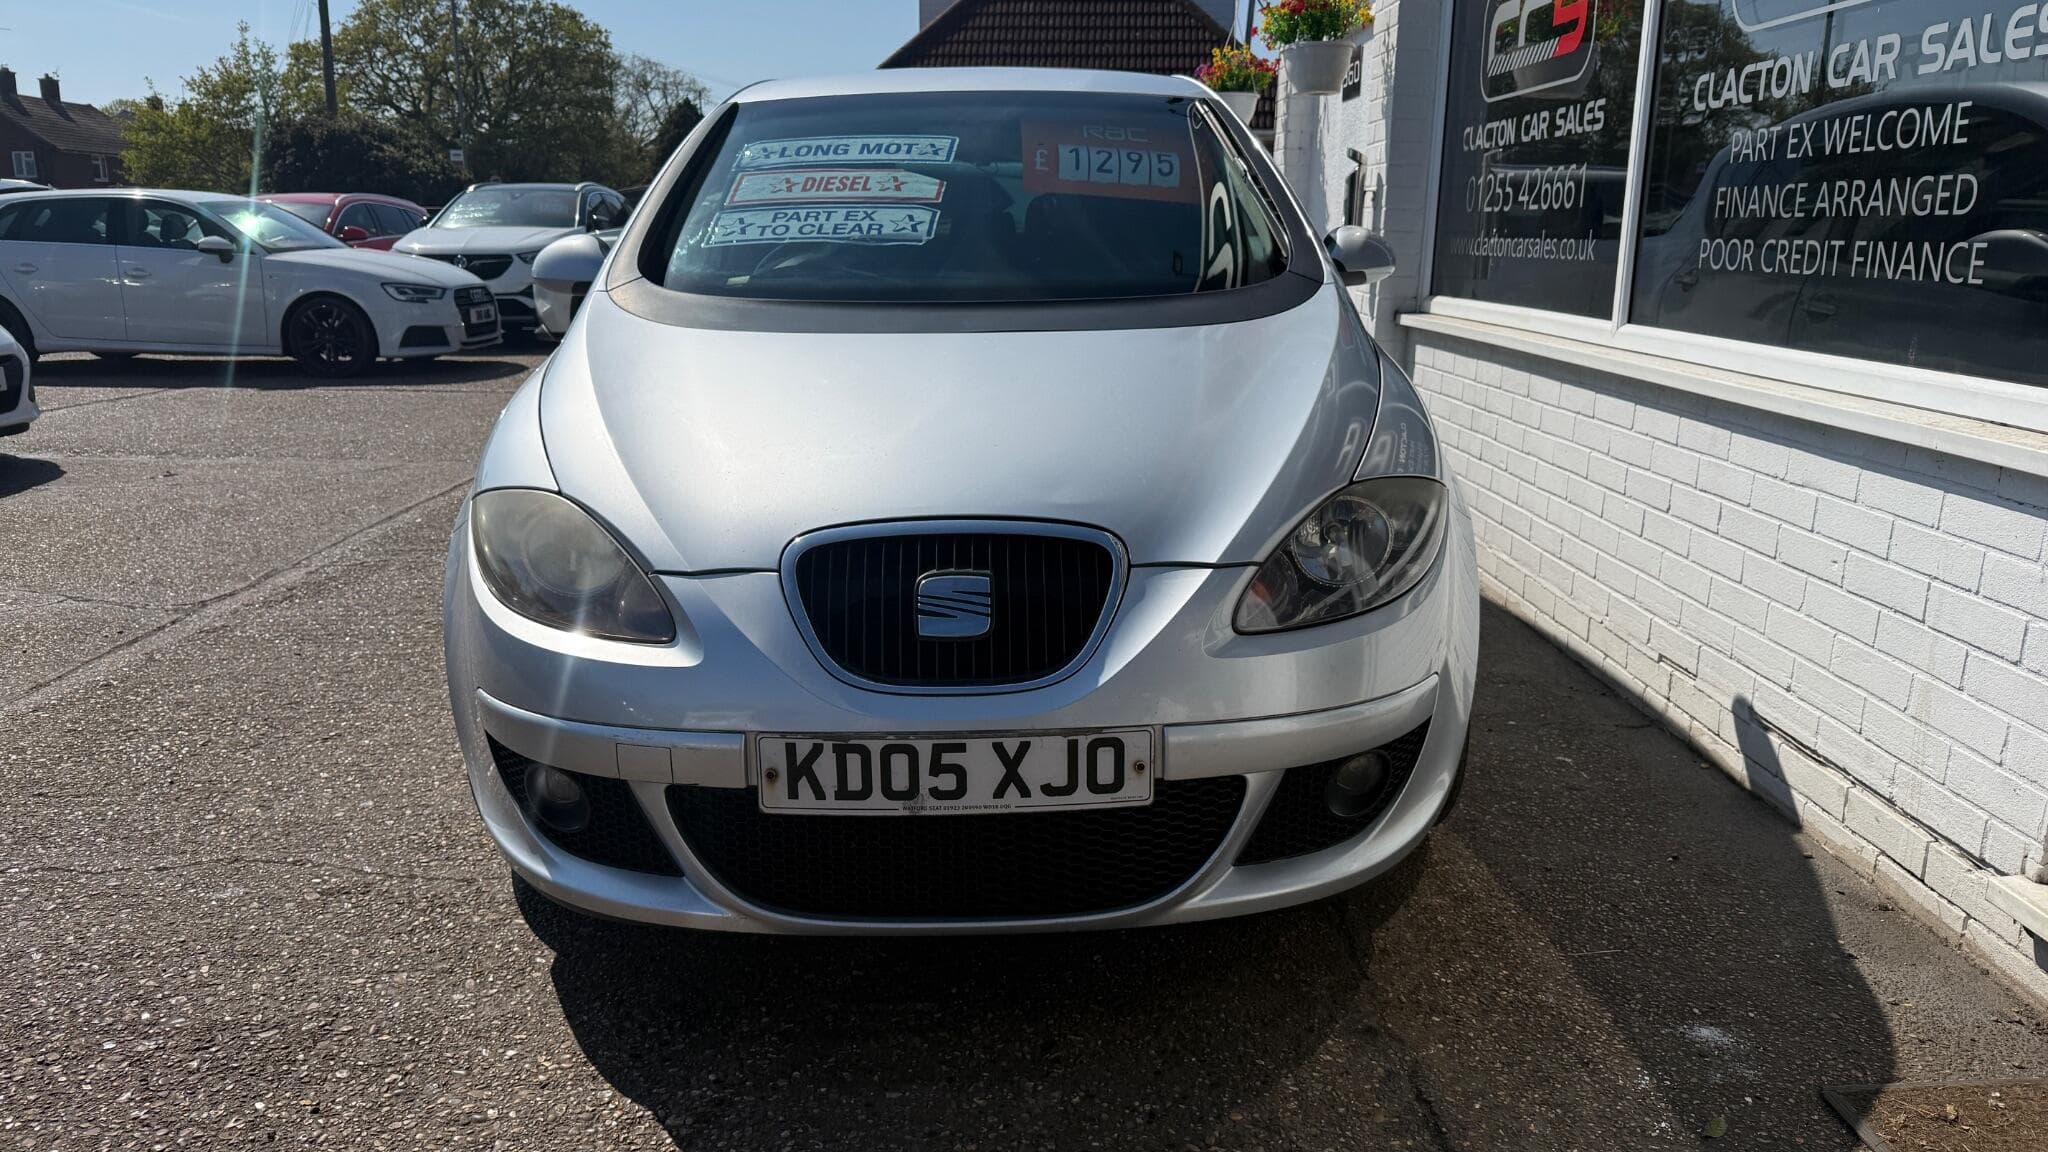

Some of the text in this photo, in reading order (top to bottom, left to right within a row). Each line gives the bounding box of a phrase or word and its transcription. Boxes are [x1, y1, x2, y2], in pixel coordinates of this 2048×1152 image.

[1692, 50, 1815, 112] CLACTON
[1827, 33, 1902, 89] CAR
[1463, 98, 1606, 151] CLACTON CAR SALES
[1729, 100, 1973, 164] PART EX WELCOME
[778, 142, 921, 158] LONG MOT
[1068, 147, 1175, 177] 1295
[800, 175, 873, 193] DIESEL
[1466, 162, 1588, 213] 01255 426661
[1714, 173, 1979, 219] FINANCE ARRANGED
[757, 222, 884, 237] TO CLEAR
[770, 210, 878, 223] PART EX
[1698, 238, 1988, 285] POOR CREDIT FINANCE
[784, 742, 969, 801] KD05
